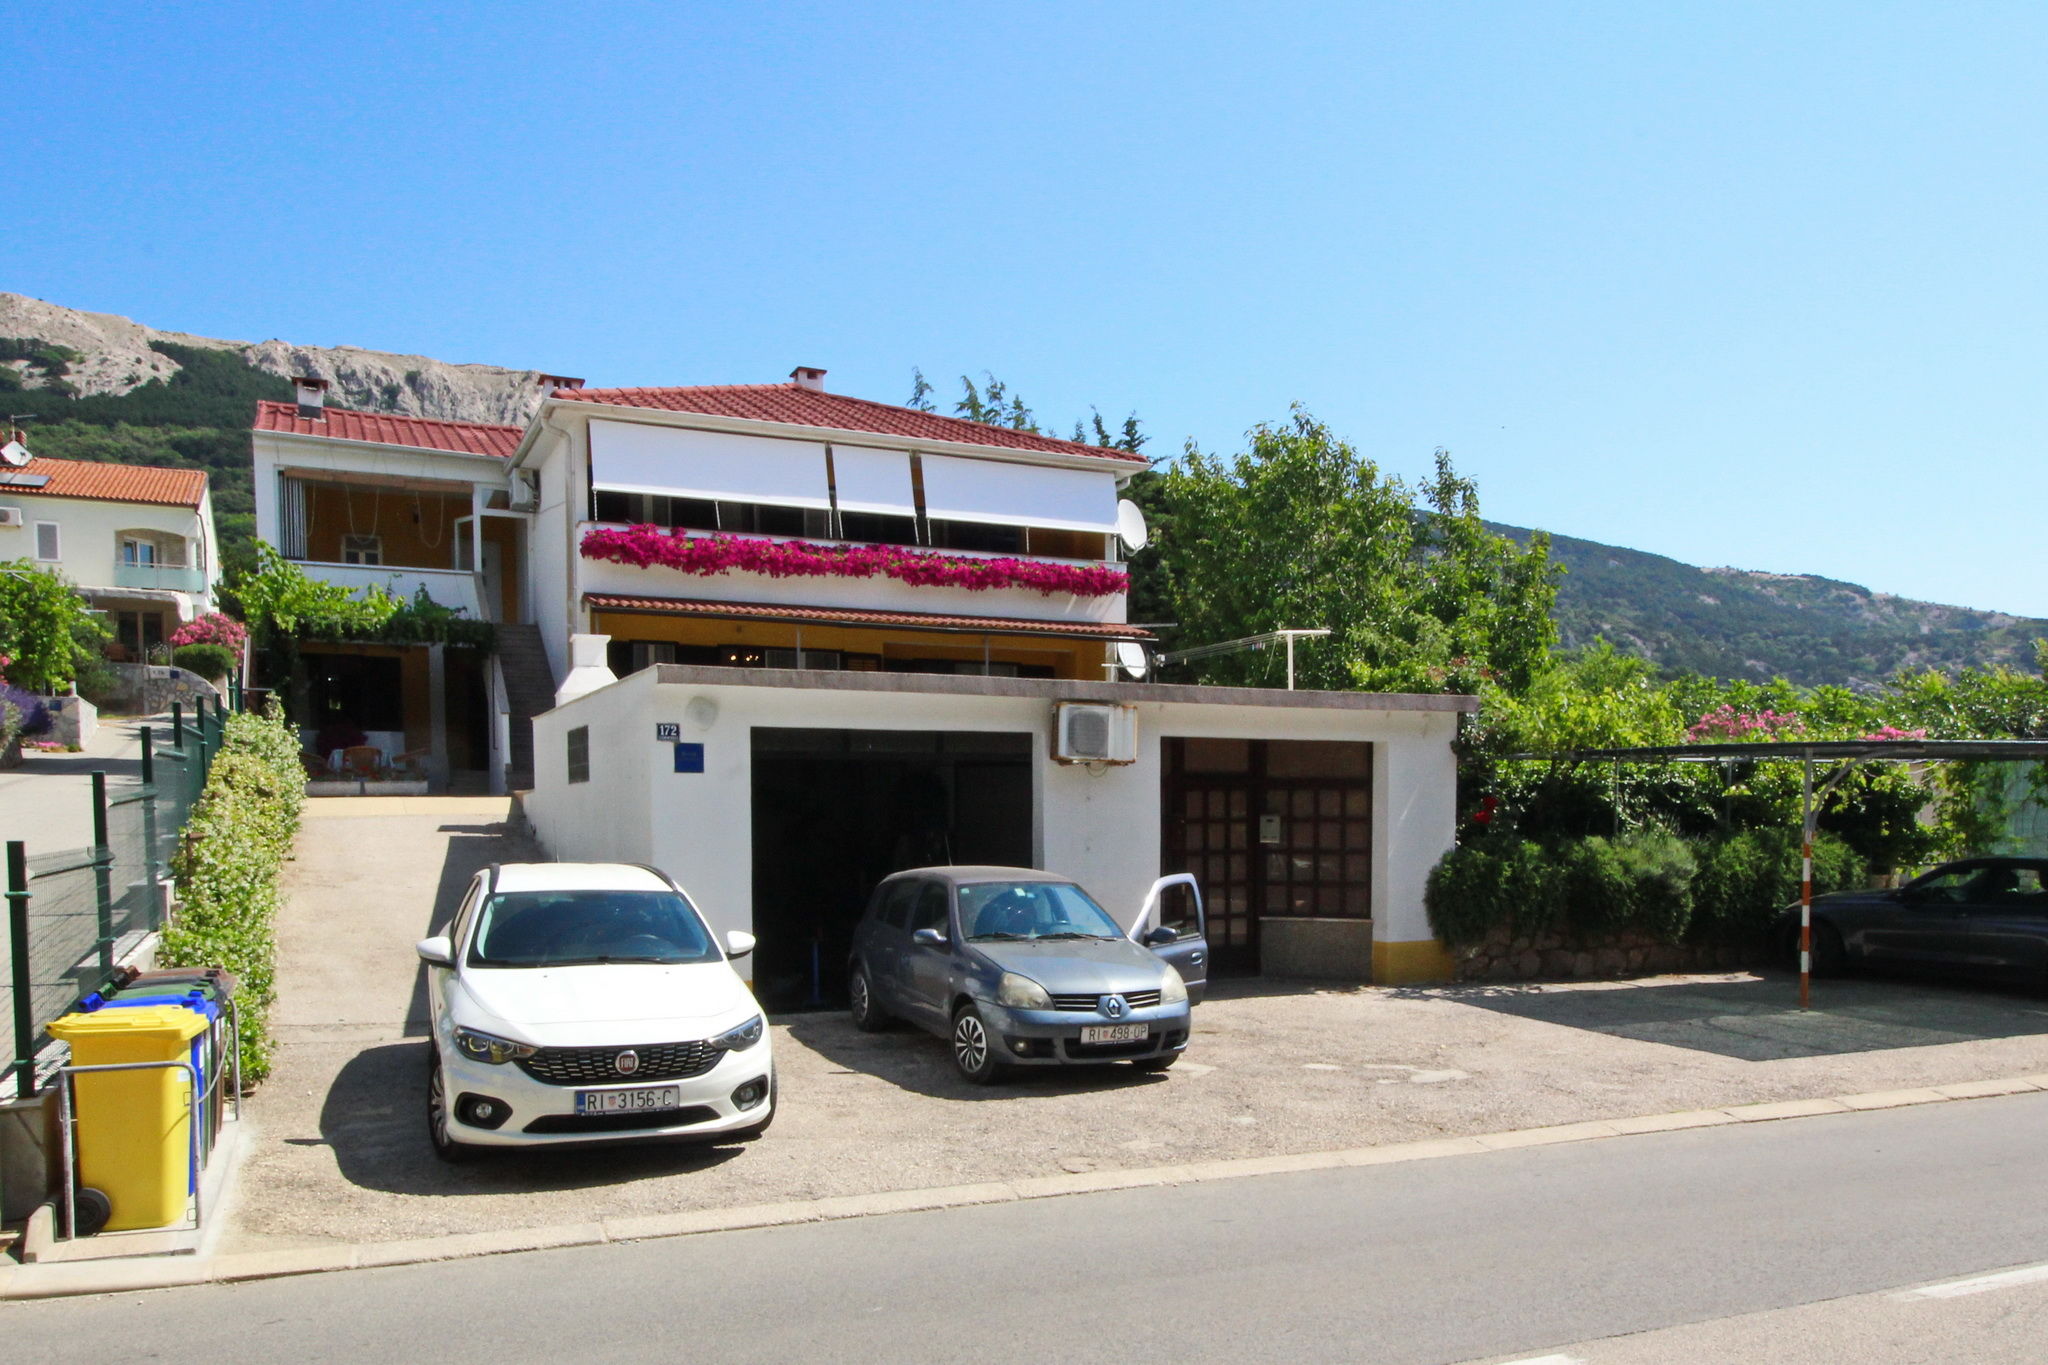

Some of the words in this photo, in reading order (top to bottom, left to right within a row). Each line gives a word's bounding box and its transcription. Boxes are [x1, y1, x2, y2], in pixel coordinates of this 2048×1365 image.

[659, 725, 677, 736] 172
[1089, 1028, 1100, 1041] RI
[587, 1094, 604, 1110] RI
[618, 1090, 672, 1109] 3156-C
